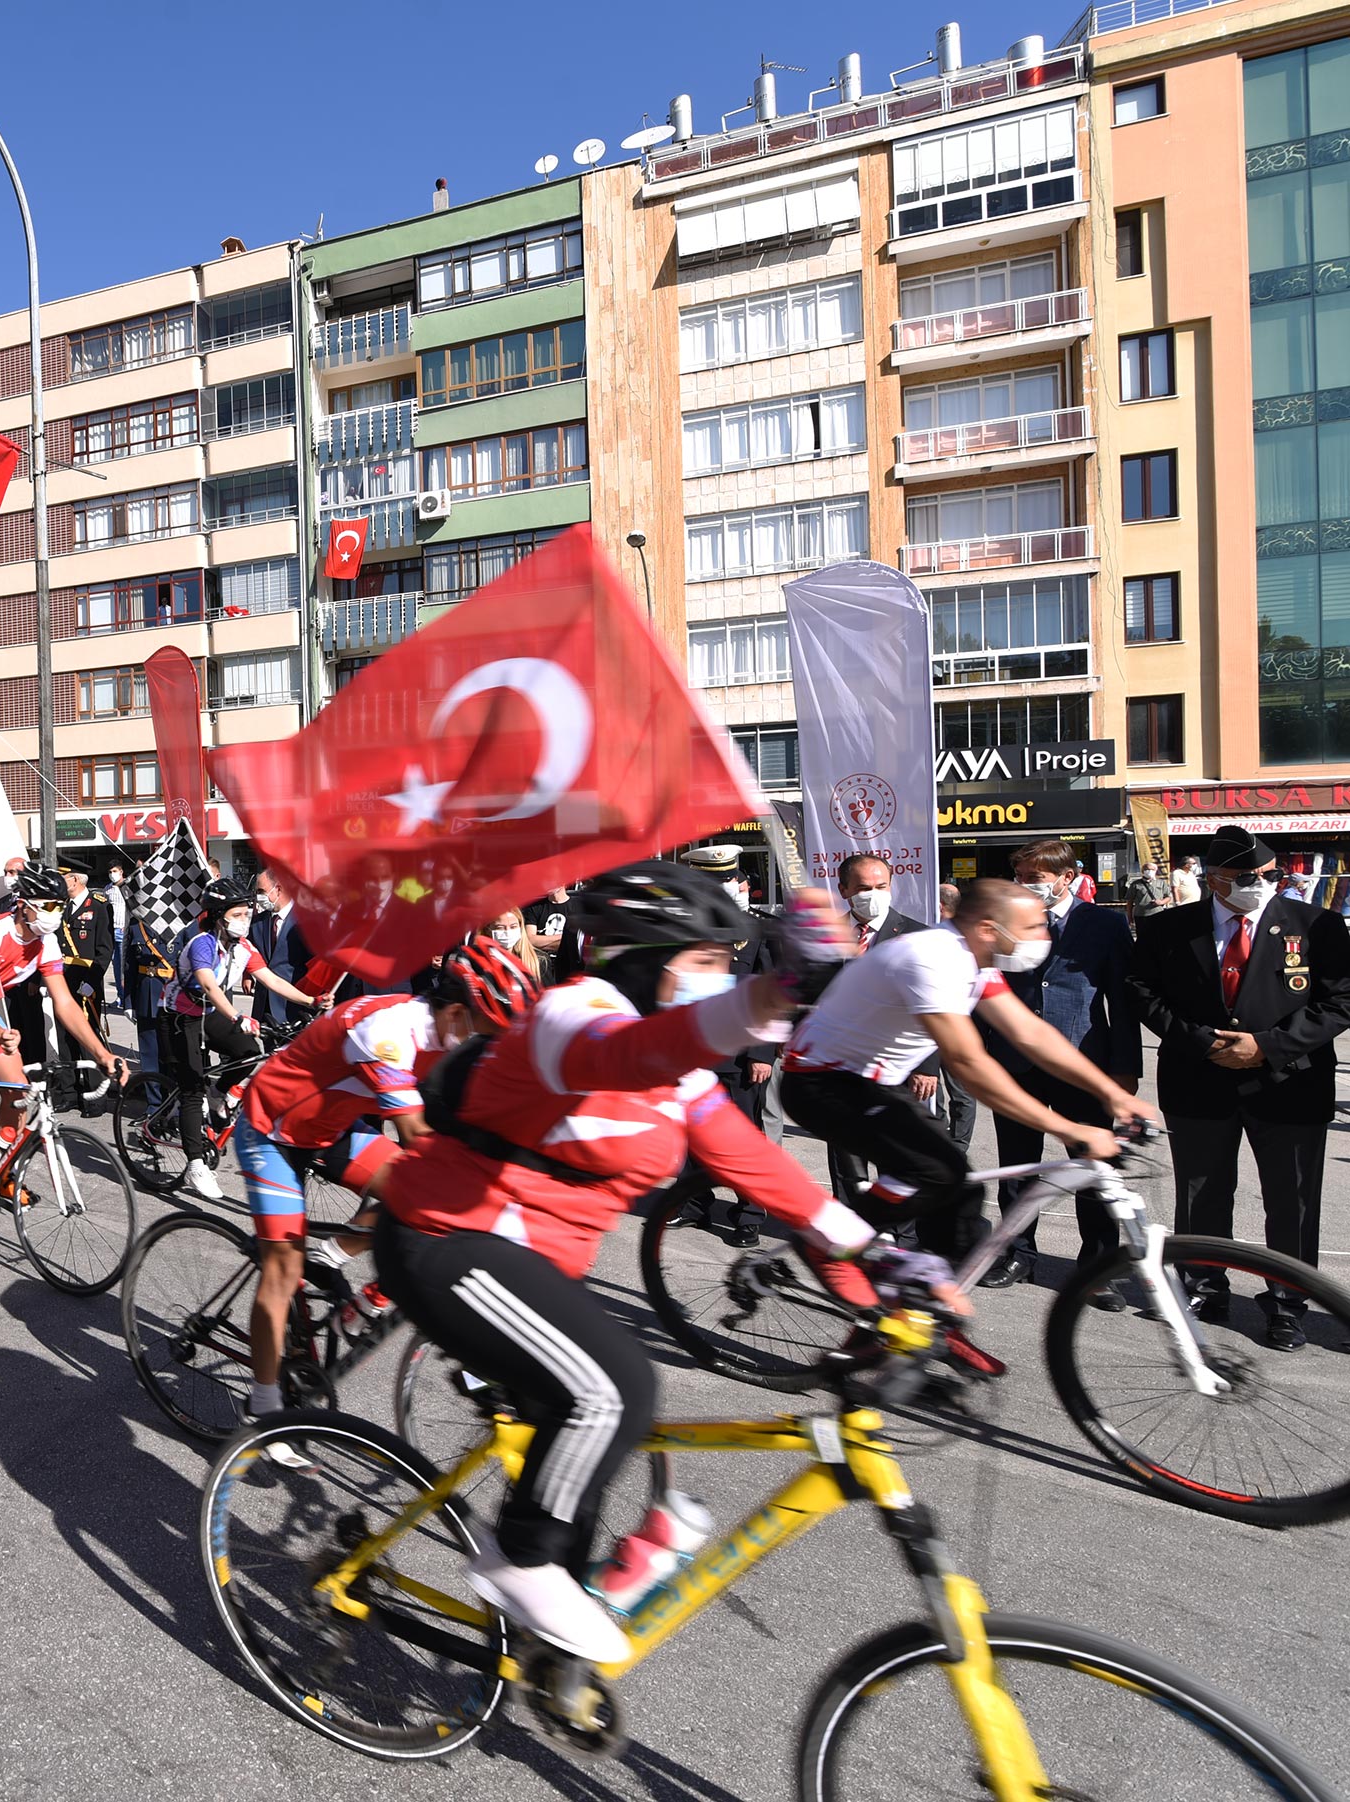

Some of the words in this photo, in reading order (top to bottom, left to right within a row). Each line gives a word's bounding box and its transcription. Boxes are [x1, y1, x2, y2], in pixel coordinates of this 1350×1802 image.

[934, 748, 1012, 782] AYA
[1035, 749, 1107, 773] Proje
[1161, 785, 1313, 810] BURSA
[101, 808, 229, 842] VESL
[937, 800, 1027, 825] ukma
[733, 822, 762, 832] WAFFLE
[1171, 823, 1222, 833] BURSA
[1235, 821, 1284, 832] UMAS
[1288, 820, 1347, 831] PAZARI
